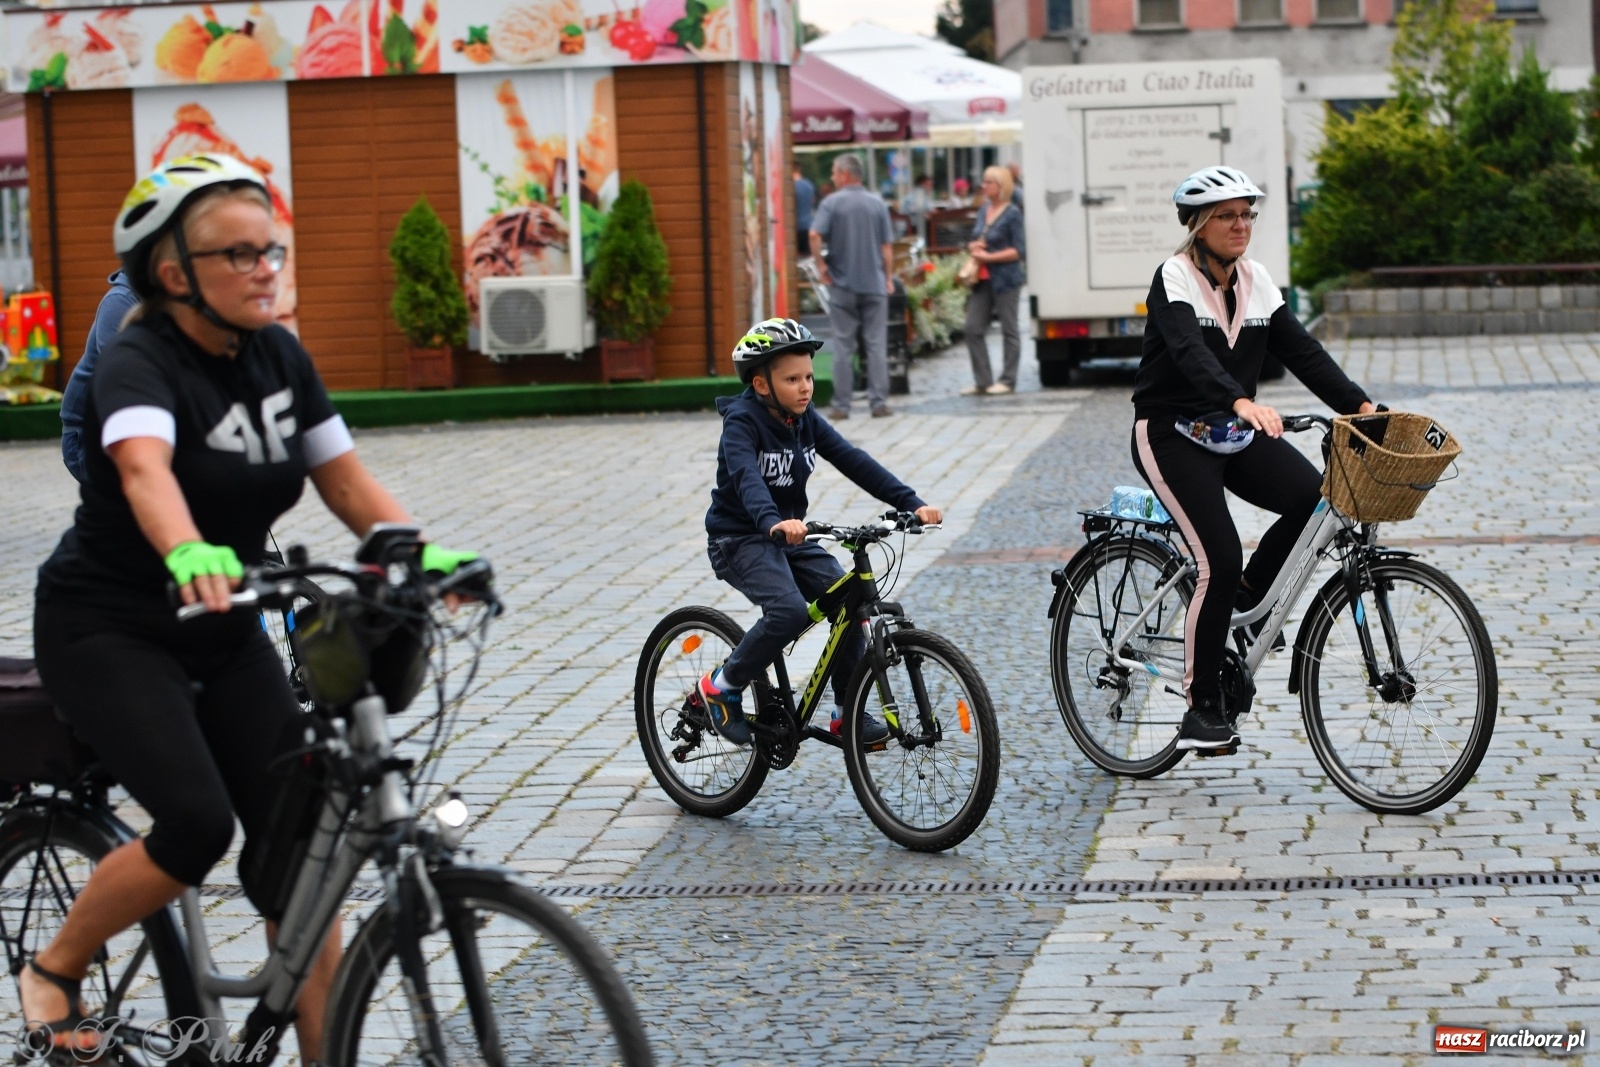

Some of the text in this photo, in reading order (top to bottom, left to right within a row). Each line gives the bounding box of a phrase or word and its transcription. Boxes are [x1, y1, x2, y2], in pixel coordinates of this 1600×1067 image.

[1029, 67, 1255, 101] Gelateria Ciao Italia
[205, 386, 297, 465] 4F
[757, 449, 795, 477] NEW
